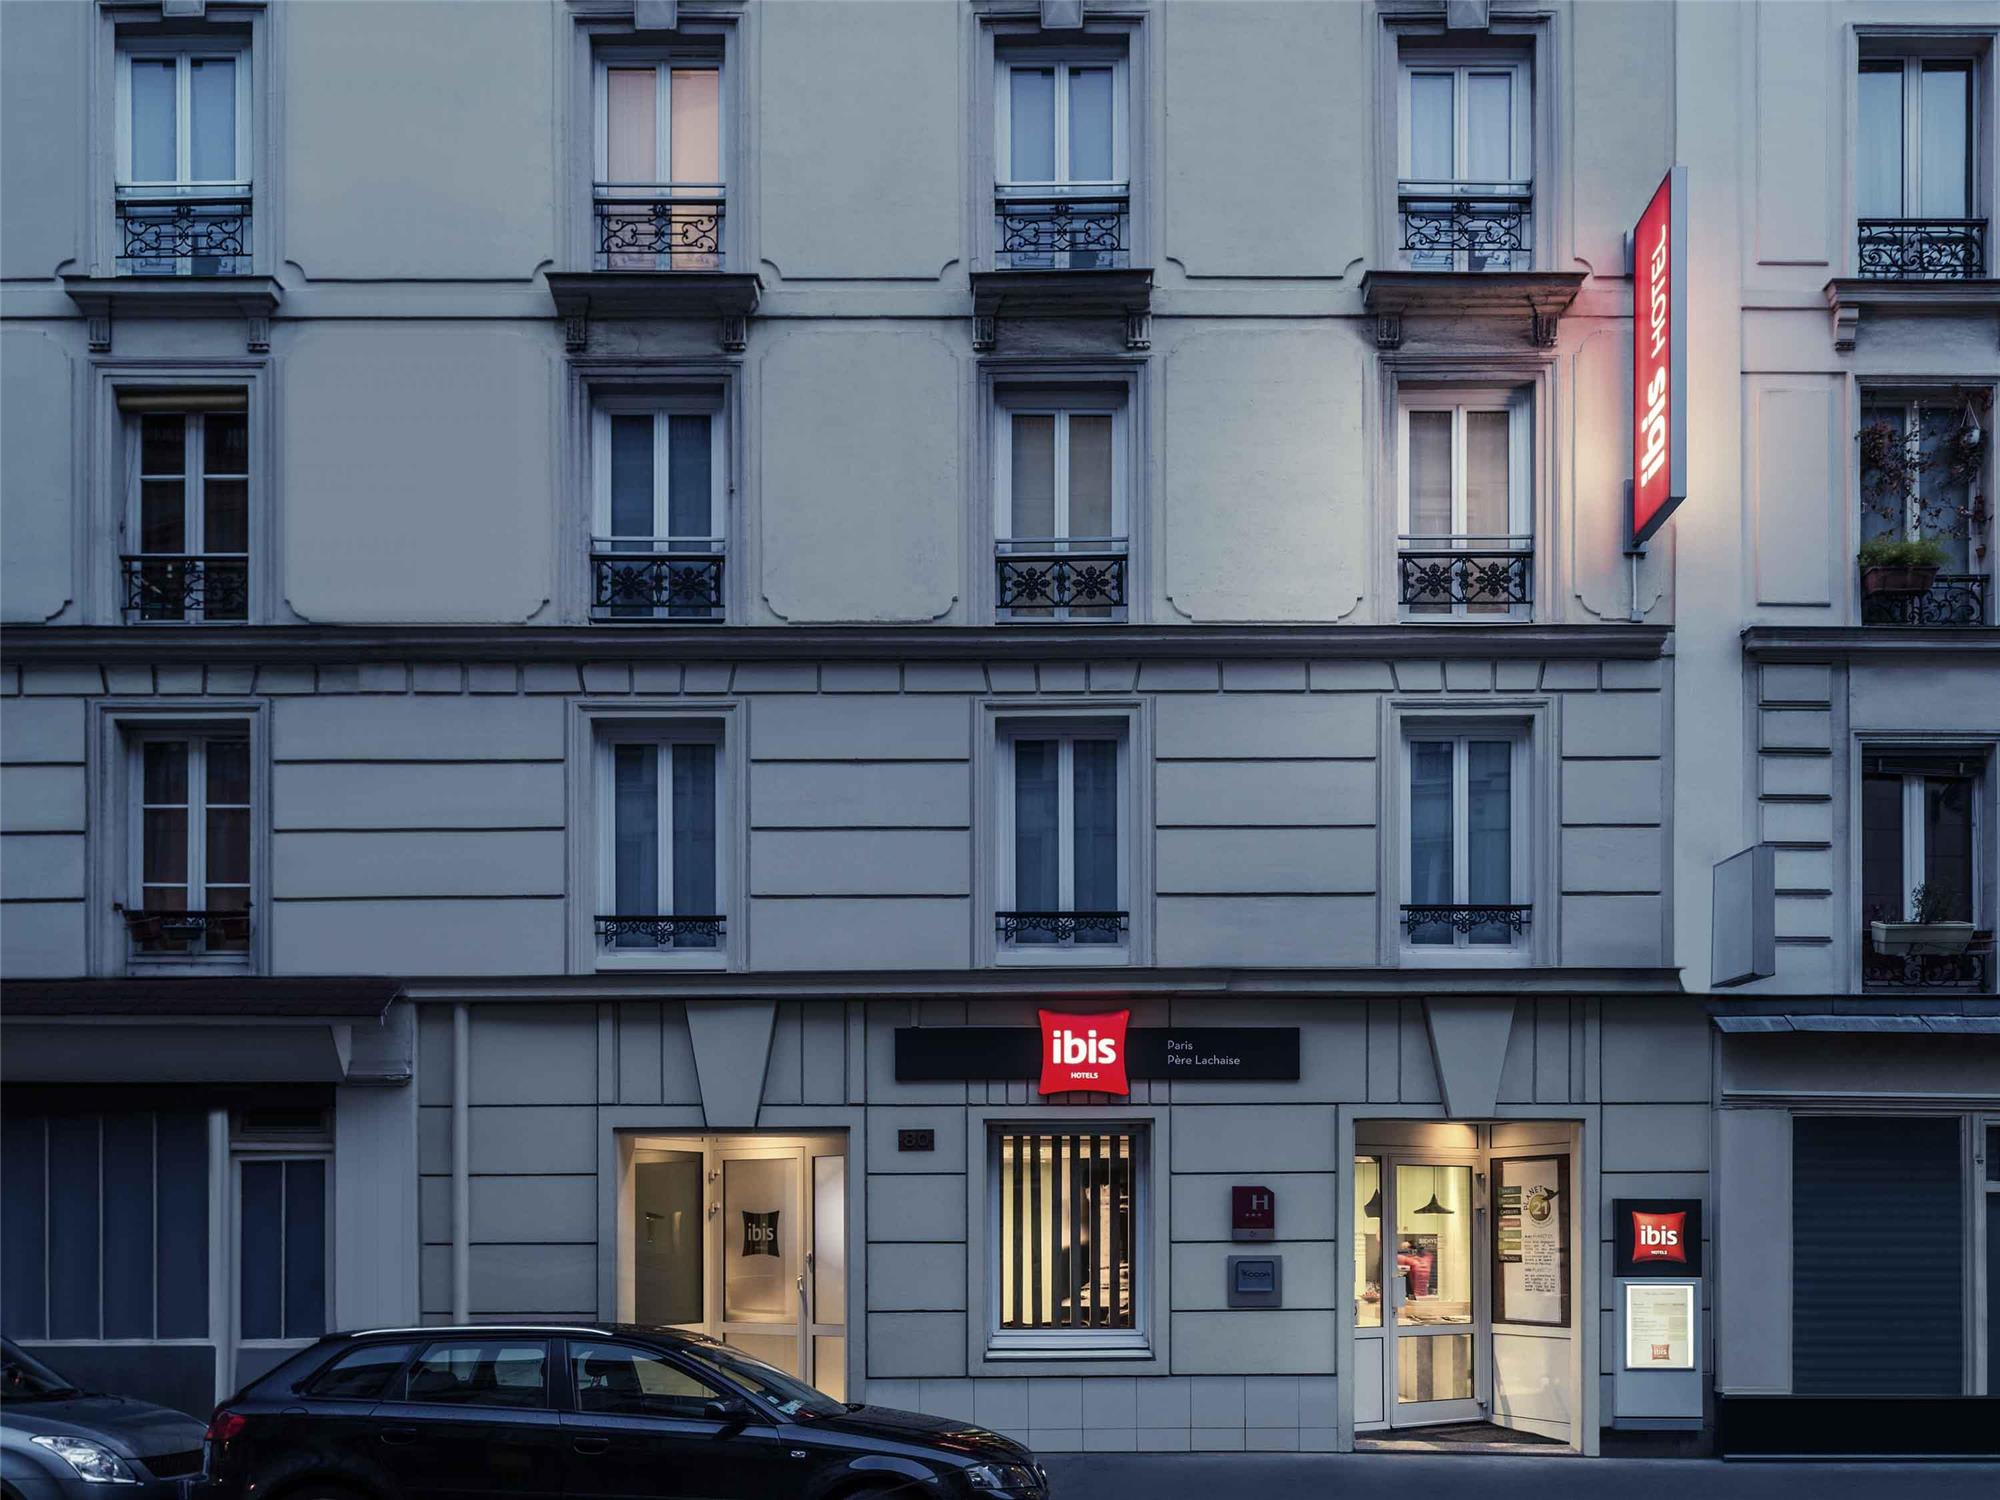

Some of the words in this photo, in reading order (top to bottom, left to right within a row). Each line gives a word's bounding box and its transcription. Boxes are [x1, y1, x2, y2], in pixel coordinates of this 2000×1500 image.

[1651, 224, 1666, 359] HOTEL
[1641, 365, 1666, 488] ibis
[1052, 1029, 1117, 1065] ibis
[1167, 1040, 1193, 1050] Paris
[1167, 1054, 1192, 1065] Père
[1195, 1054, 1241, 1065] Lachaise
[1070, 1071, 1099, 1079] HOTELS
[1251, 1194, 1269, 1211] H
[1523, 1185, 1544, 1211] PLANET
[1532, 1200, 1548, 1215] 21
[748, 1222, 774, 1241] ibis
[1640, 1224, 1678, 1246] ibis
